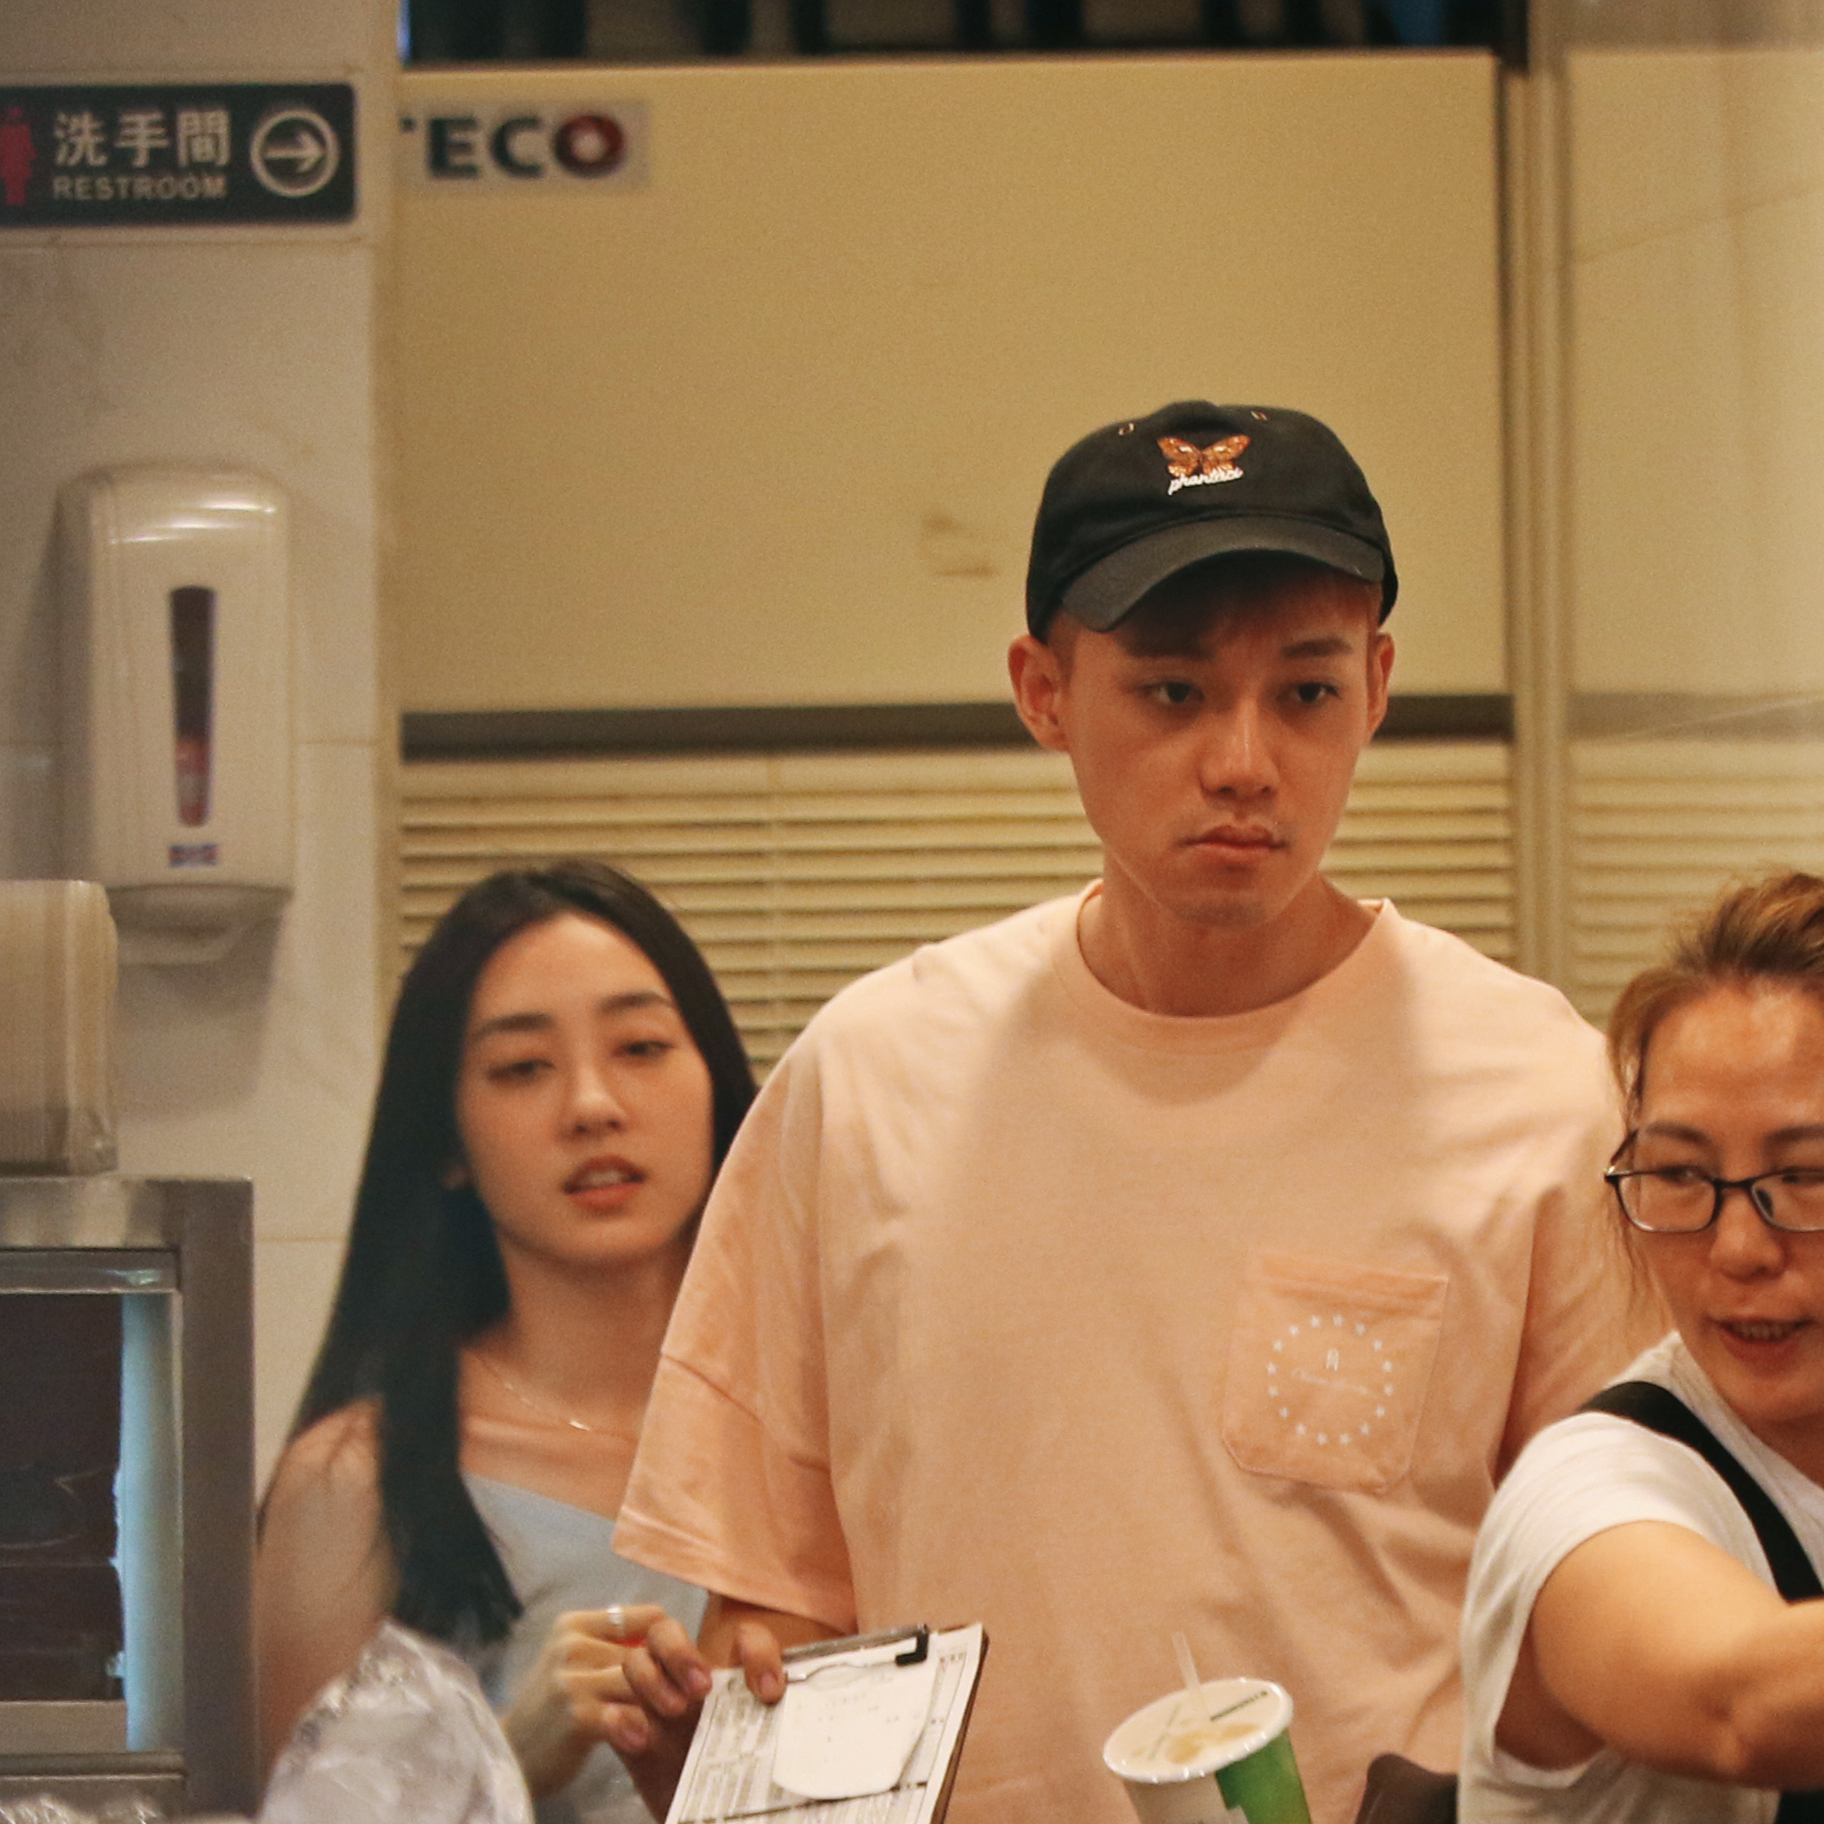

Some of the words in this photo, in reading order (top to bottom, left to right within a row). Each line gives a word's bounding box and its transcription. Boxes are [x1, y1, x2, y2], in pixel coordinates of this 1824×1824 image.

[53, 110, 230, 168] 洗手間
[399, 113, 626, 178] ECO
[52, 174, 226, 200] RESTROOM
